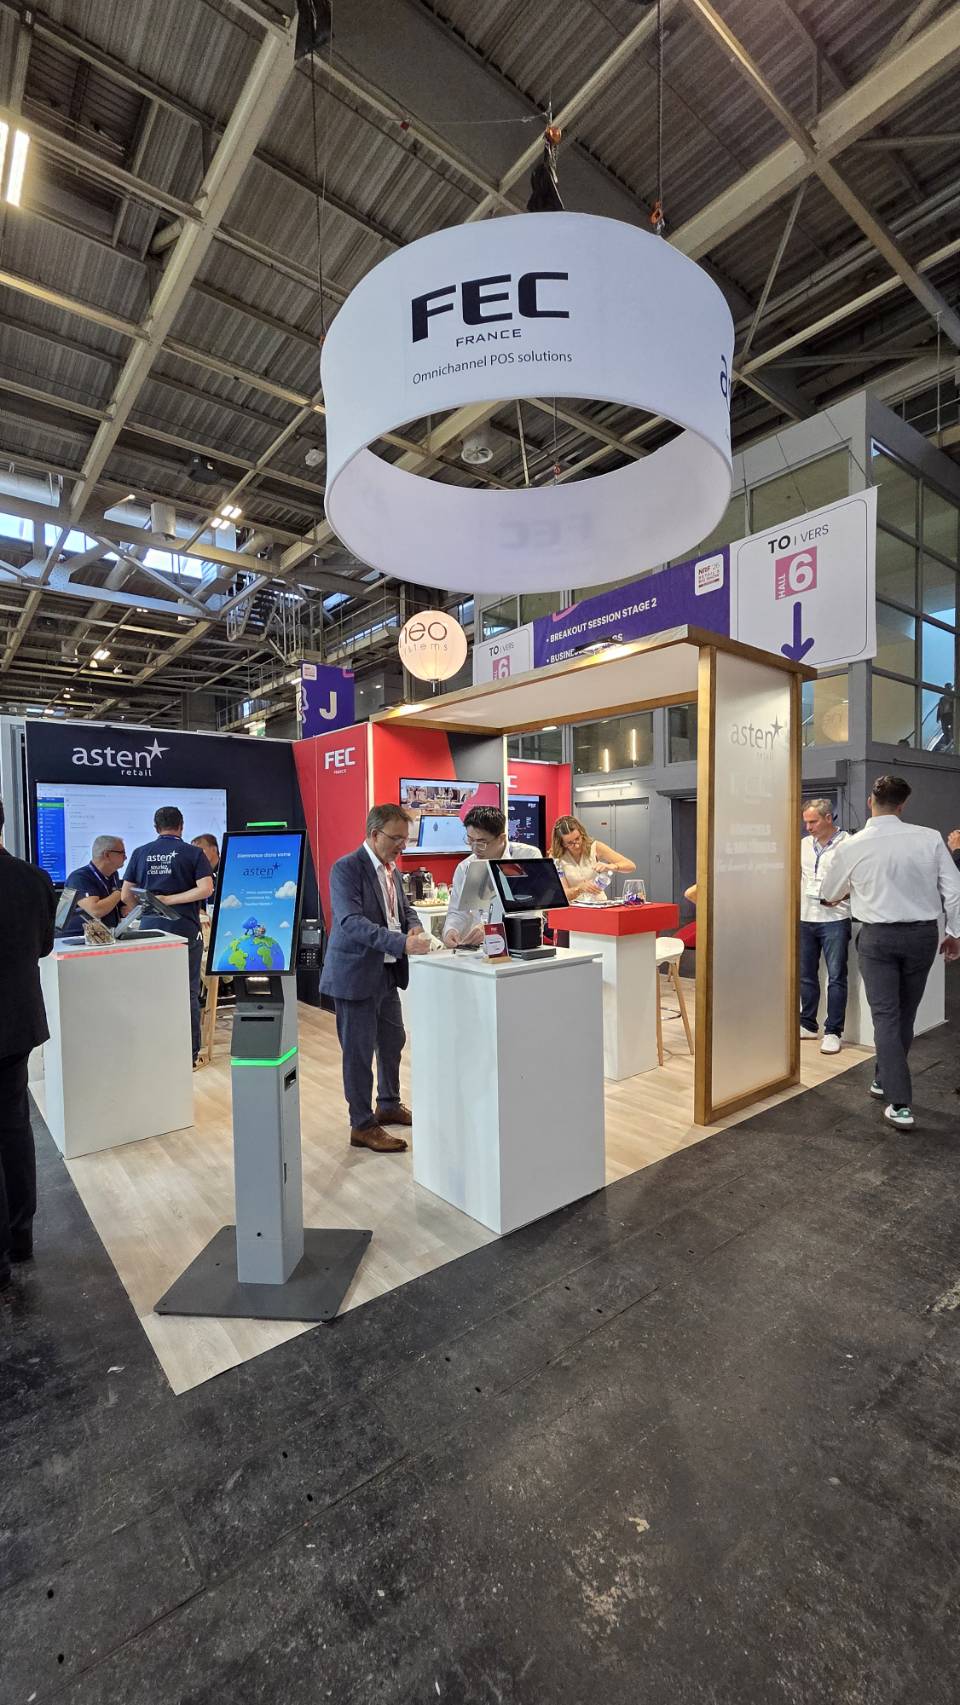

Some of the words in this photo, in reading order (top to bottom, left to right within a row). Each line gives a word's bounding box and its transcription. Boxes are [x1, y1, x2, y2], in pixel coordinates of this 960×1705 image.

[411, 271, 570, 343] FEC
[455, 328, 522, 347] FRANCE
[412, 356, 487, 385] Omnichannel
[490, 353, 515, 366] POS
[517, 350, 573, 363] solutions
[768, 535, 791, 553] TO
[800, 524, 829, 542] VERS
[778, 573, 786, 599] HALL
[788, 553, 813, 591] 6
[550, 622, 587, 643] BREAKOUT
[588, 610, 621, 630] SESSION
[622, 600, 650, 618] STAGE
[651, 597, 658, 609] 2
[489, 645, 500, 657] TO
[550, 647, 582, 663] BUSINE
[498, 658, 509, 679] 6
[319, 691, 337, 720] J
[730, 723, 774, 750] asten
[72, 747, 151, 769] asten
[324, 746, 356, 769] FEC
[121, 769, 152, 777] retail
[146, 854, 172, 862] asten
[243, 867, 274, 877] asten
